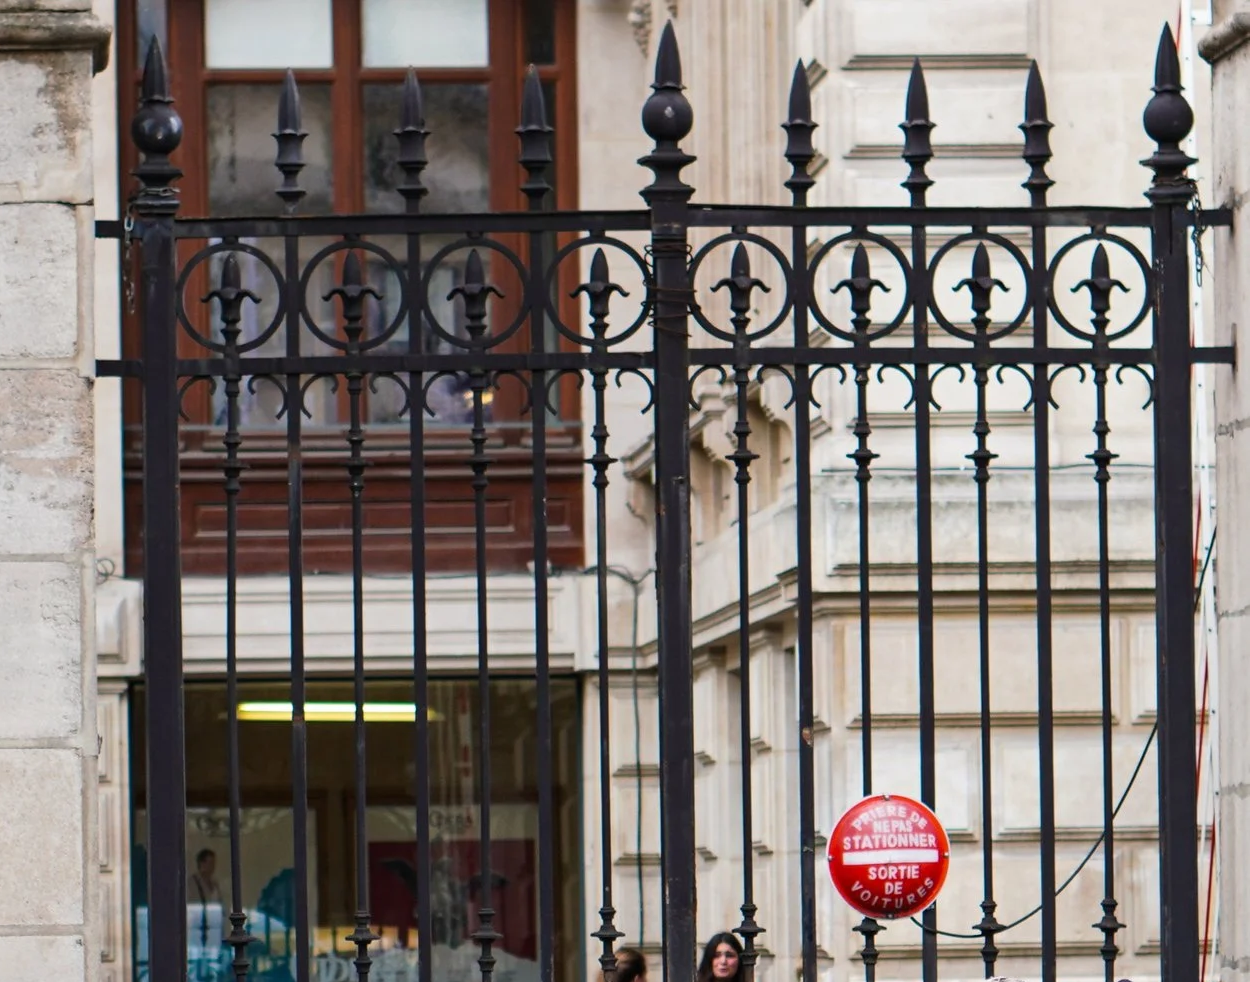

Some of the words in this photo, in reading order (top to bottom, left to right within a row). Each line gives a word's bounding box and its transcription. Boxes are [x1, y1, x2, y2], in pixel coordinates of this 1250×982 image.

[874, 821, 890, 832] NE
[892, 821, 913, 832] PAS
[910, 812, 927, 829] DE
[844, 834, 936, 850] STATIONNER
[869, 866, 919, 880] SORTIE
[851, 878, 934, 908] VOITURES
[885, 882, 902, 895] DE
